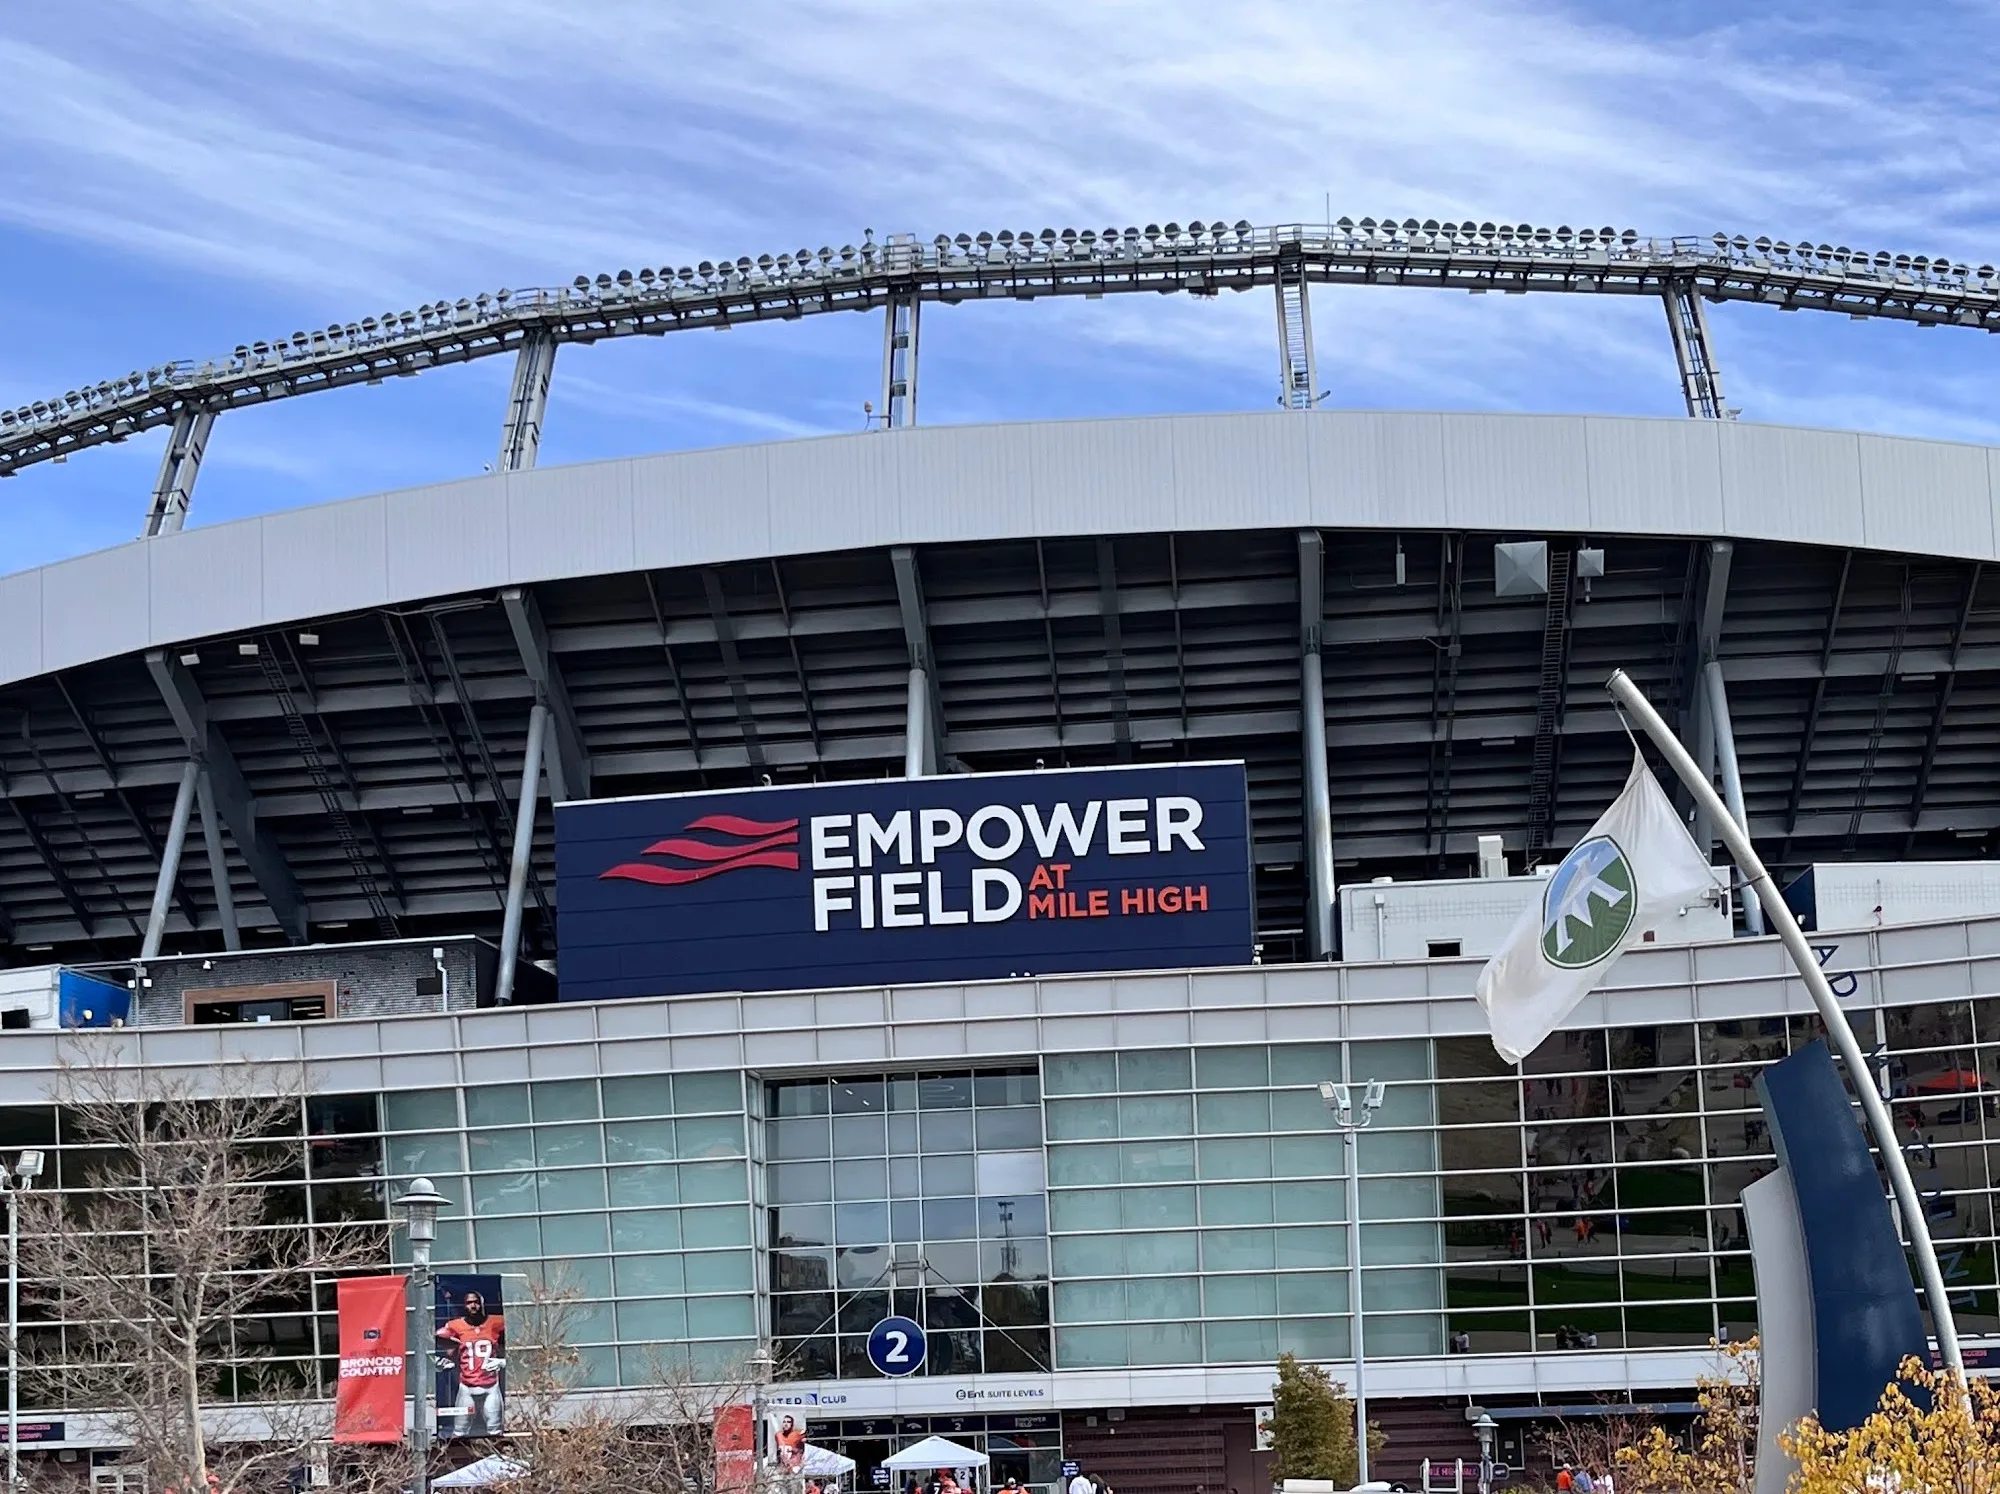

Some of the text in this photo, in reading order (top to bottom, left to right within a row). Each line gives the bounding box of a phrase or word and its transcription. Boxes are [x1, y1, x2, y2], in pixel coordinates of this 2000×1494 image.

[810, 796, 1206, 870] EMPOWER
[1028, 864, 1072, 891] AT
[813, 868, 1023, 932] FIELD
[1028, 885, 1209, 920] MILE HIGH
[885, 1330, 909, 1363] 2
[465, 1340, 493, 1371] 19
[340, 1357, 403, 1369] BRONCOS
[340, 1366, 403, 1378] COUNTRY
[821, 1396, 847, 1404] CLUB
[967, 1390, 985, 1399] Ent
[1014, 1389, 1044, 1397] LEVELS
[866, 1425, 873, 1434] 2
[954, 1423, 962, 1431] 2
[960, 1471, 966, 1480] 2
